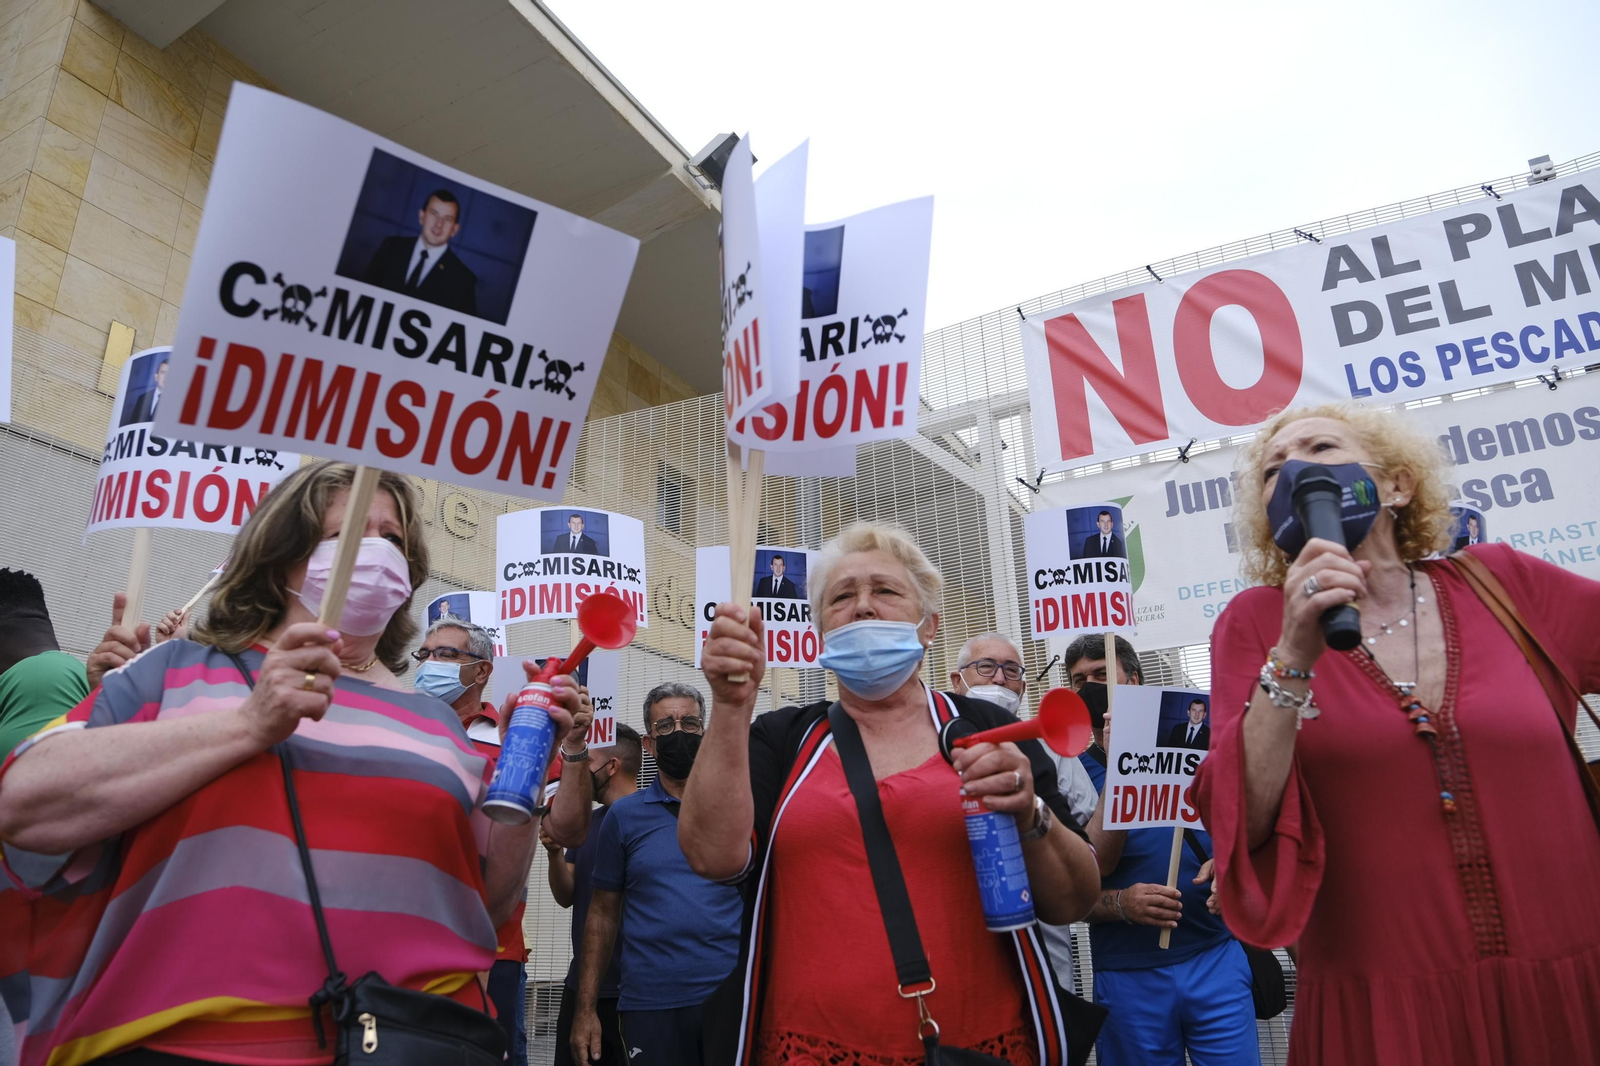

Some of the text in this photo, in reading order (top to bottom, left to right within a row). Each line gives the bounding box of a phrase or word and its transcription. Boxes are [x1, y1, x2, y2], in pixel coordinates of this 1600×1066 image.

[1321, 184, 1600, 292] AL PLA
[1330, 279, 1493, 347] DEL
[1043, 268, 1304, 462] NO
[1344, 350, 1426, 400] LOS
[179, 336, 572, 490] ¡DIMISIÓN!
[1437, 406, 1600, 467] demos
